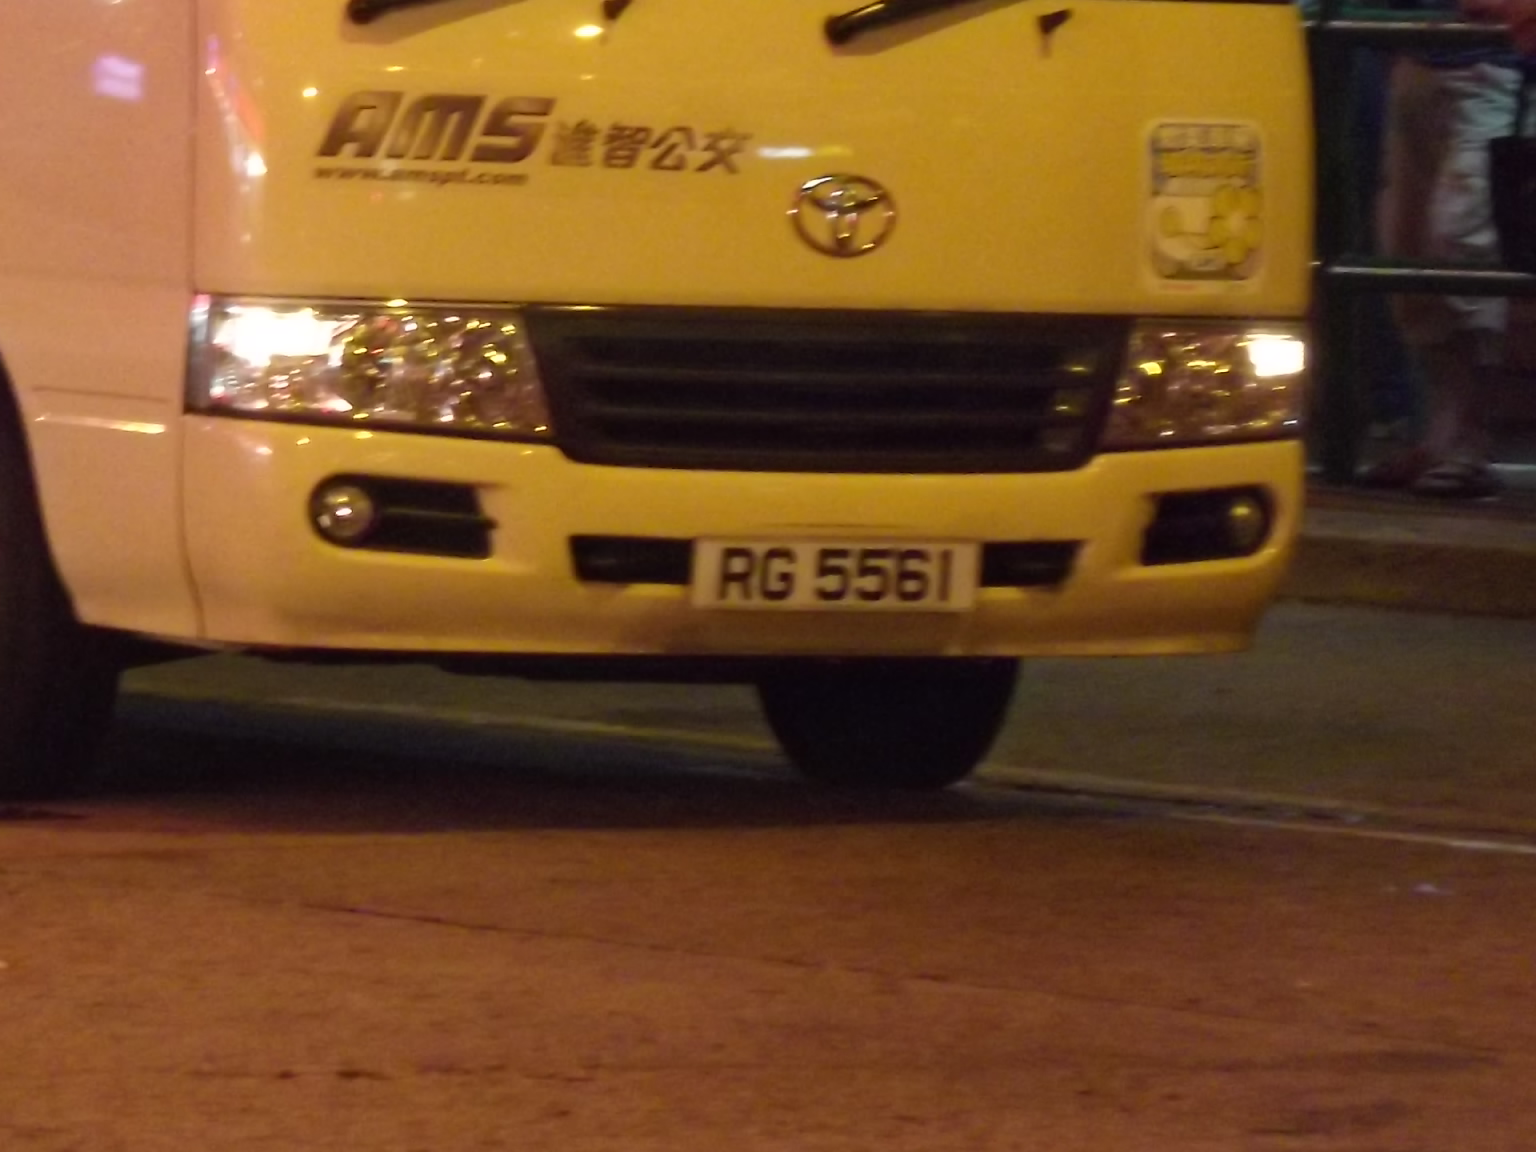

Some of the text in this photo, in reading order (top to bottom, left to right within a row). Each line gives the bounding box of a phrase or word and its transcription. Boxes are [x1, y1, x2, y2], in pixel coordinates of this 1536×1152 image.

[316, 90, 557, 164] AMS
[550, 118, 752, 176] 進智公交
[717, 547, 955, 603] RG 5561
